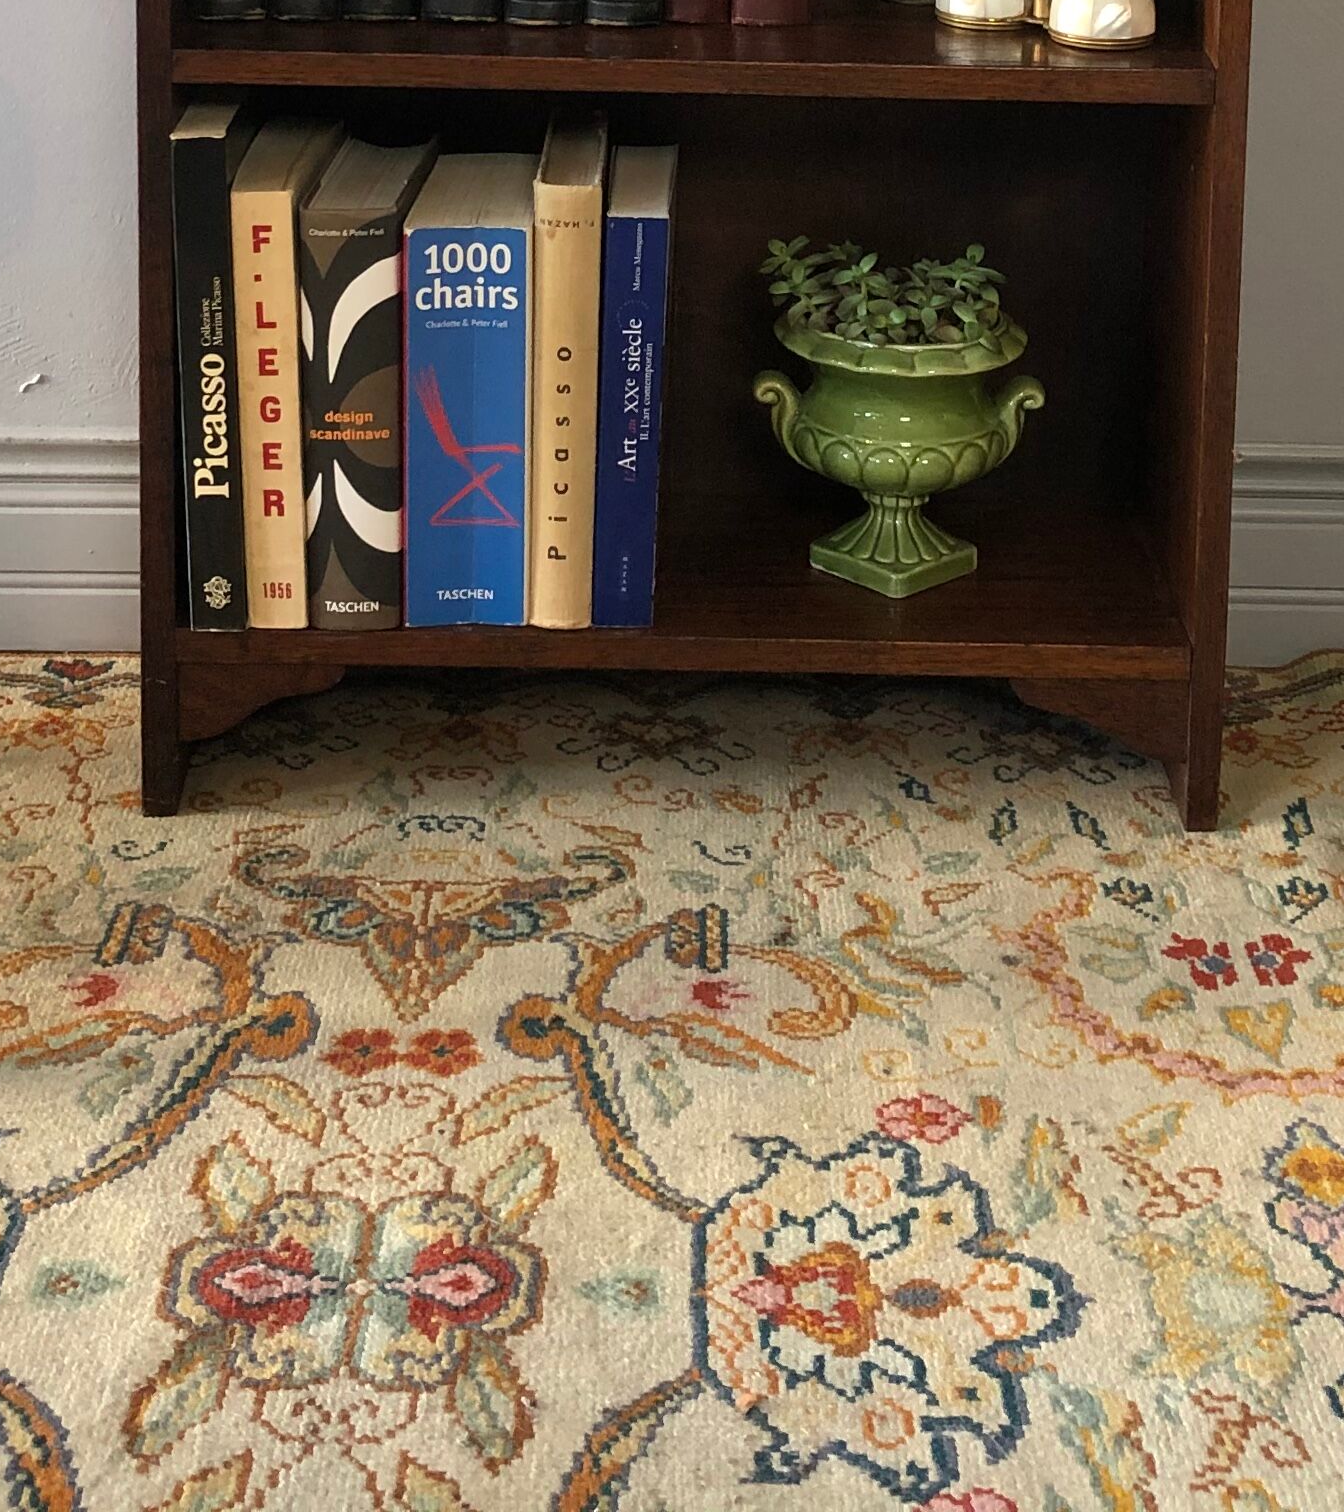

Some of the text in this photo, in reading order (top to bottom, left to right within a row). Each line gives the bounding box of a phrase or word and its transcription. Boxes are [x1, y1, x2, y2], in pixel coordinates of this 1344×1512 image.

[424, 242, 512, 275] 1000
[415, 276, 519, 311] chairs
[200, 298, 212, 347] Collezione
[210, 276, 224, 347] Marina Picasso
[462, 318, 469, 327] &
[471, 319, 490, 327] Peter
[621, 318, 643, 372] siècle
[642, 343, 655, 406] contemporain
[192, 352, 230, 499] Picasso
[324, 410, 374, 425] design
[640, 408, 651, 428] L'art
[309, 428, 391, 441] scandinave
[547, 346, 572, 561] Picasso
[262, 582, 293, 600] 1956
[325, 601, 380, 613] TASCHEN
[436, 588, 494, 601] TASCHEN
